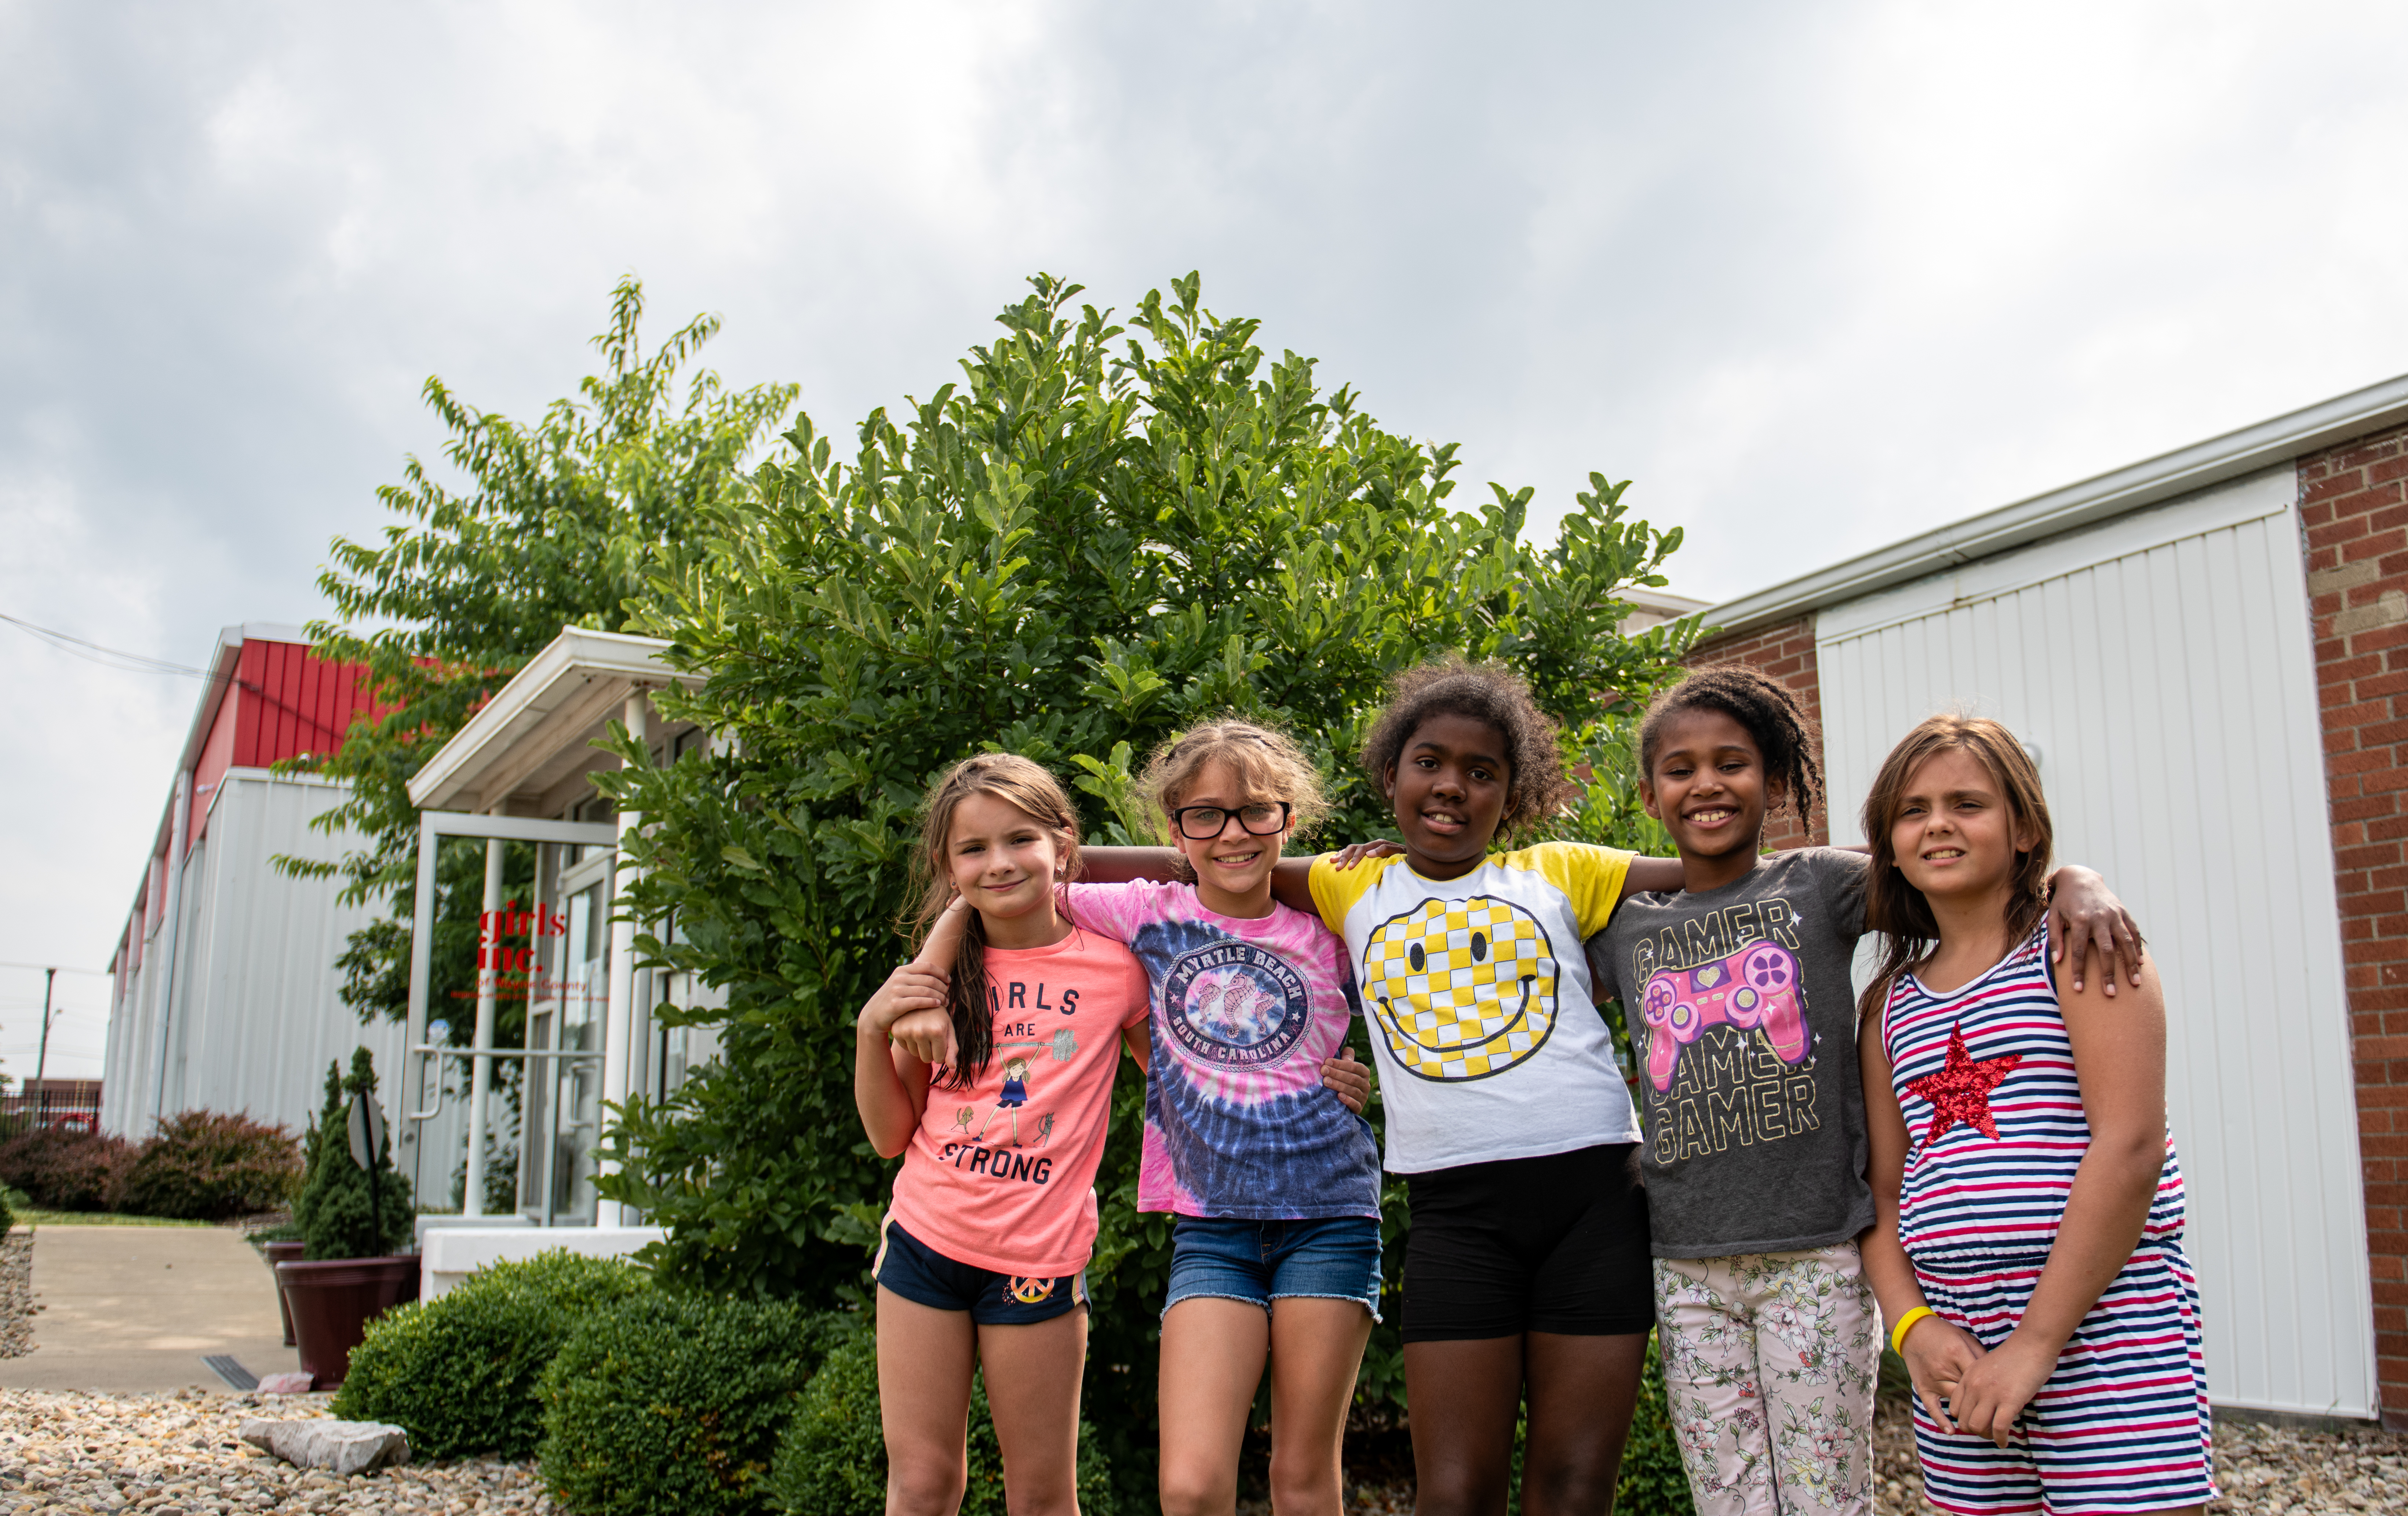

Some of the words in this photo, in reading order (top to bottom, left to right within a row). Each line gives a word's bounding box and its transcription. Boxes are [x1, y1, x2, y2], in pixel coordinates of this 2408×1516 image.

[479, 900, 566, 945] girls
[478, 947, 543, 974] inc.
[1633, 898, 1800, 993] GAMER
[476, 977, 489, 987] of
[494, 977, 536, 992] Wayne
[540, 978, 587, 992] County
[1175, 947, 1247, 984] MYRTLE
[1253, 950, 1303, 1000] BEACH
[992, 982, 1079, 1015] IRLS
[1004, 1024, 1035, 1037] ARE
[1173, 1016, 1210, 1055] SOUTH
[1217, 1032, 1291, 1061] CAROLINA
[1650, 1026, 1815, 1106] AME
[1655, 1075, 1820, 1164] GAMER
[938, 1143, 1052, 1185] STRONG
